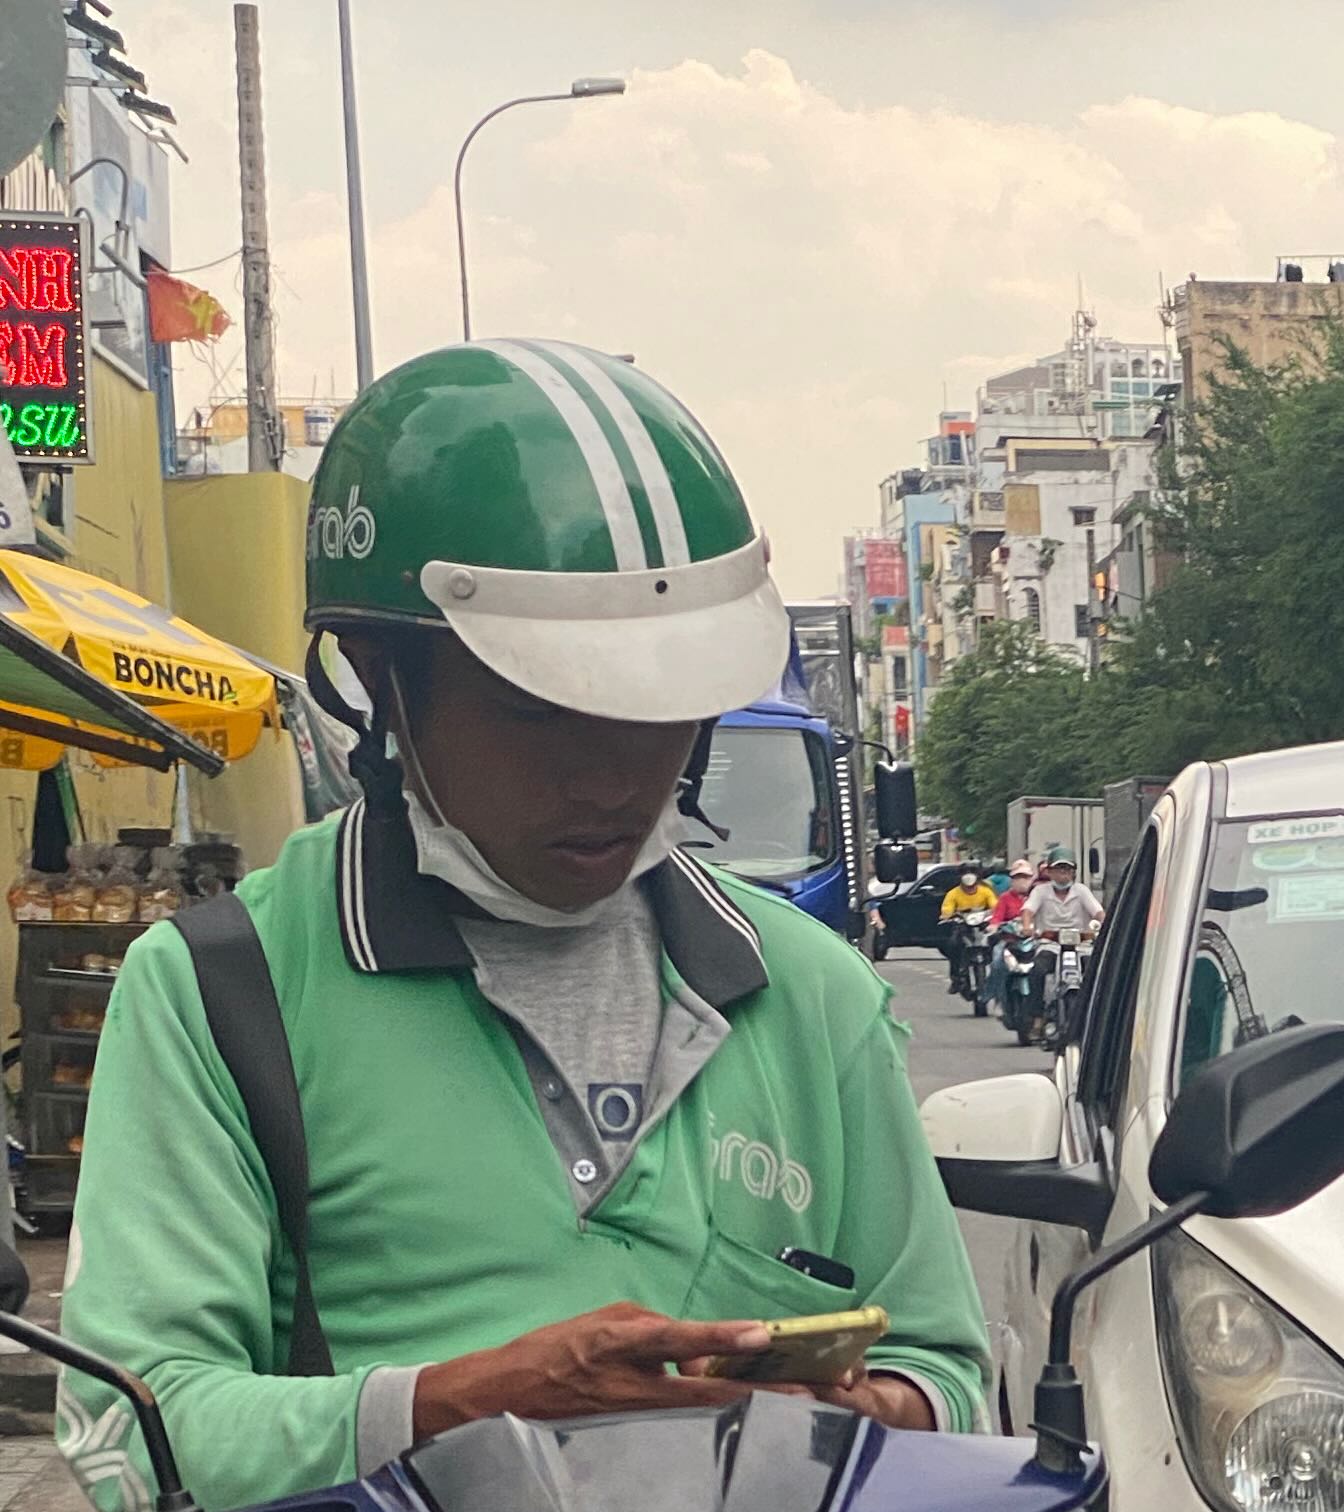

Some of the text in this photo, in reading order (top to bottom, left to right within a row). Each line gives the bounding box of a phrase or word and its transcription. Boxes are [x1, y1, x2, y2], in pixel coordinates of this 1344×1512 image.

[308, 484, 376, 560] rab
[113, 651, 240, 706] BONCHA
[710, 1130, 813, 1214] rab
